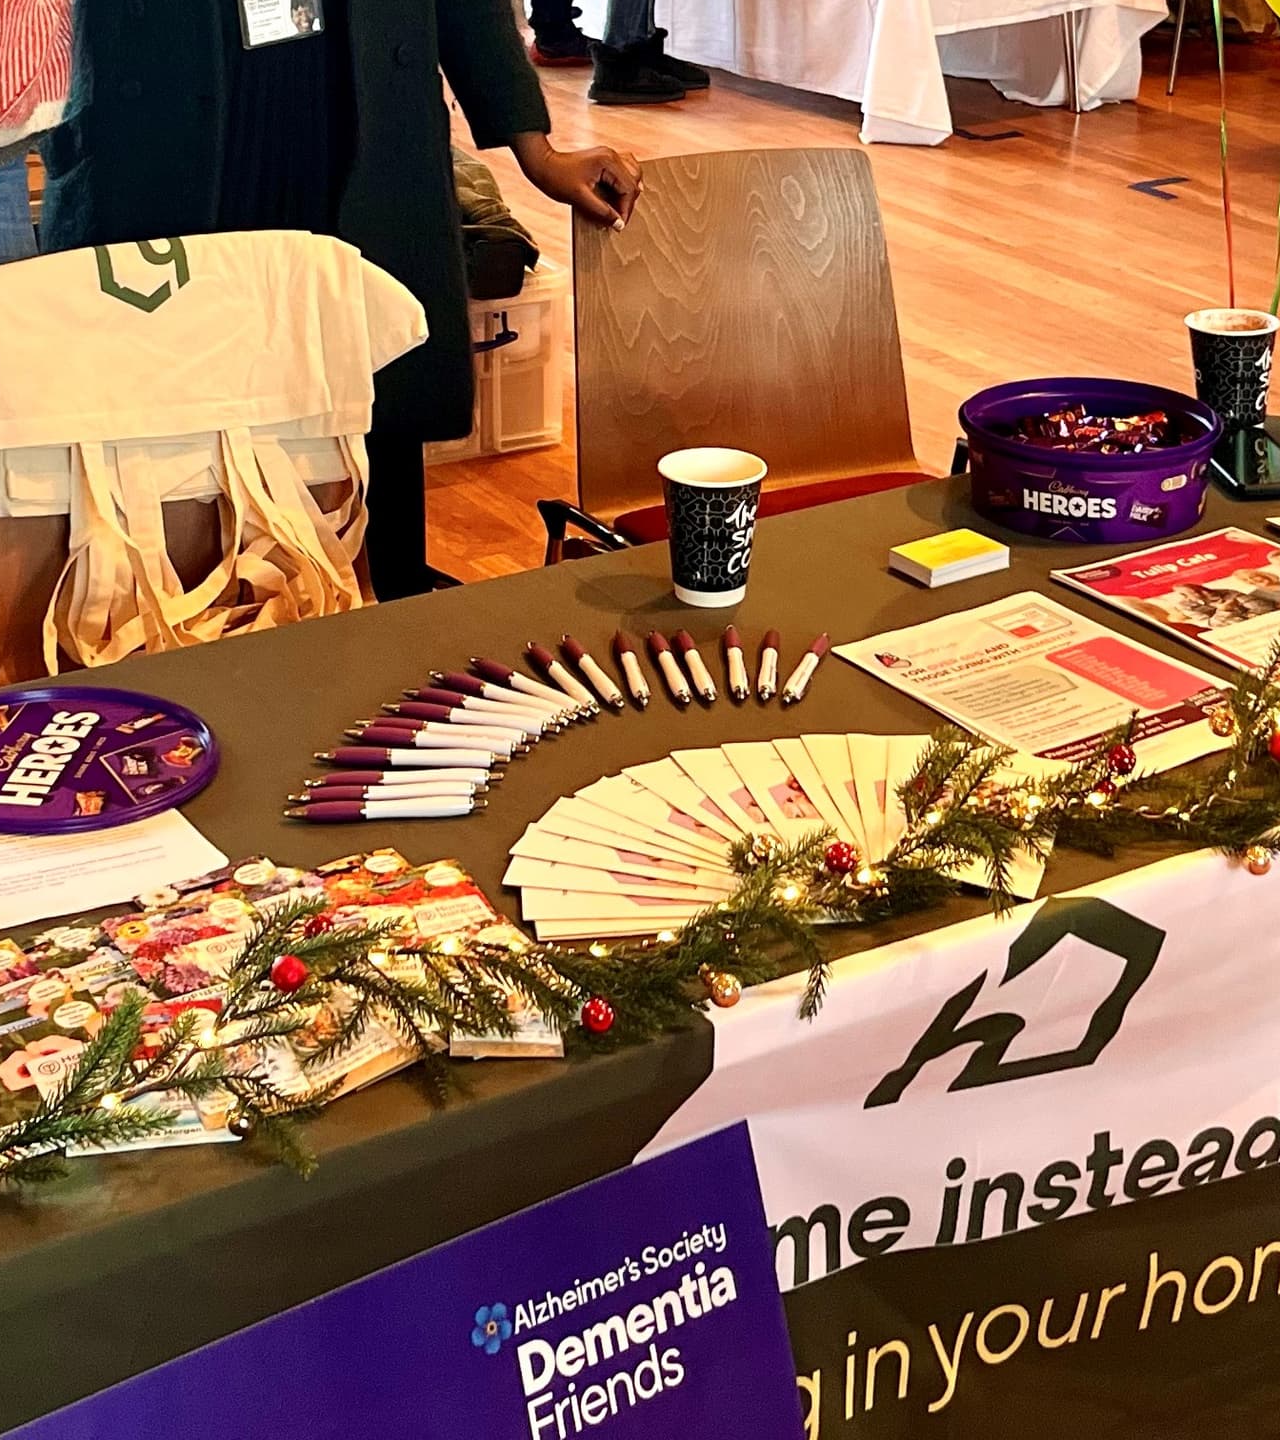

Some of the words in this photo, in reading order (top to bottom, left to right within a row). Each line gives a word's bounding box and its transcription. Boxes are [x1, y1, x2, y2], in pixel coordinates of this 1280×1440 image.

[1022, 487, 1118, 520] HEROES
[1131, 557, 1179, 580] Tulip
[985, 641, 1010, 656] AND
[991, 648, 1021, 663] WITH
[514, 1256, 642, 1336] Alzheimer’s
[641, 1222, 728, 1276] Society
[770, 1195, 910, 1291] me
[516, 1261, 738, 1398] Dementia
[844, 1331, 910, 1421] in
[927, 1279, 1127, 1414] your
[526, 1343, 686, 1440] Friends
